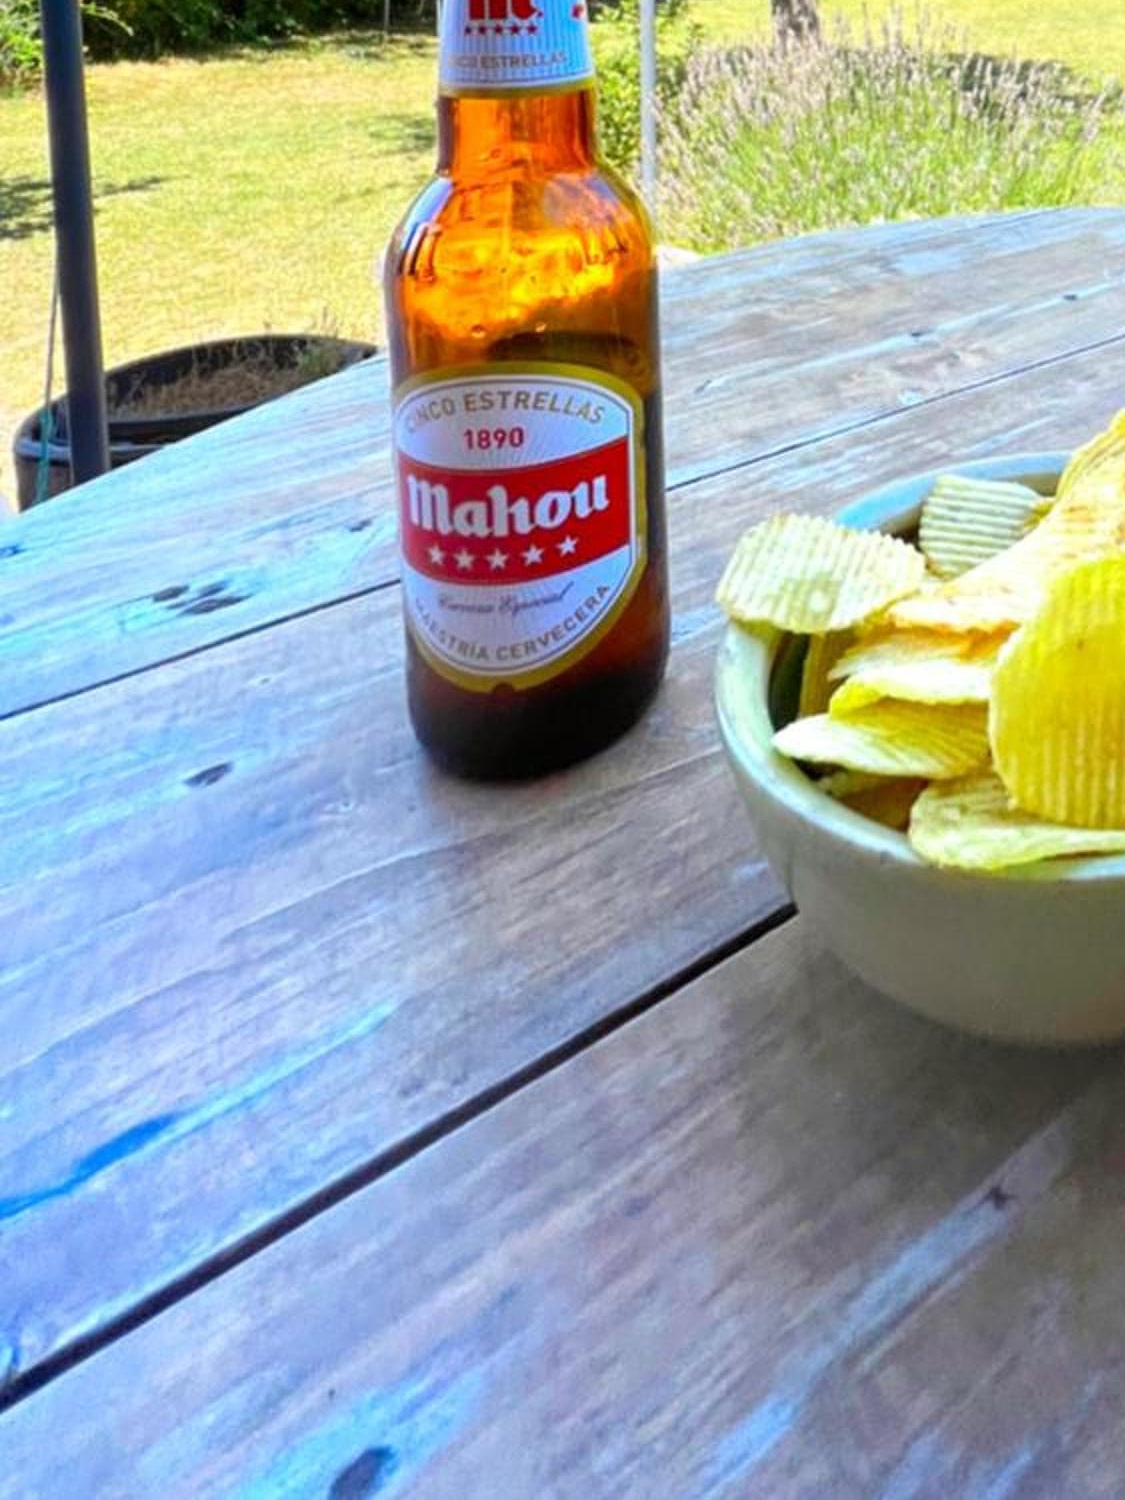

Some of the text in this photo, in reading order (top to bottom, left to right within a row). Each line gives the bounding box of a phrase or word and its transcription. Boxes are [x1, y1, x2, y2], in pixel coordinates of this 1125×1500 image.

[464, 391, 606, 423] ESTRELLAS
[464, 427, 524, 449] 1890
[496, 585, 610, 661] CERVECERA
